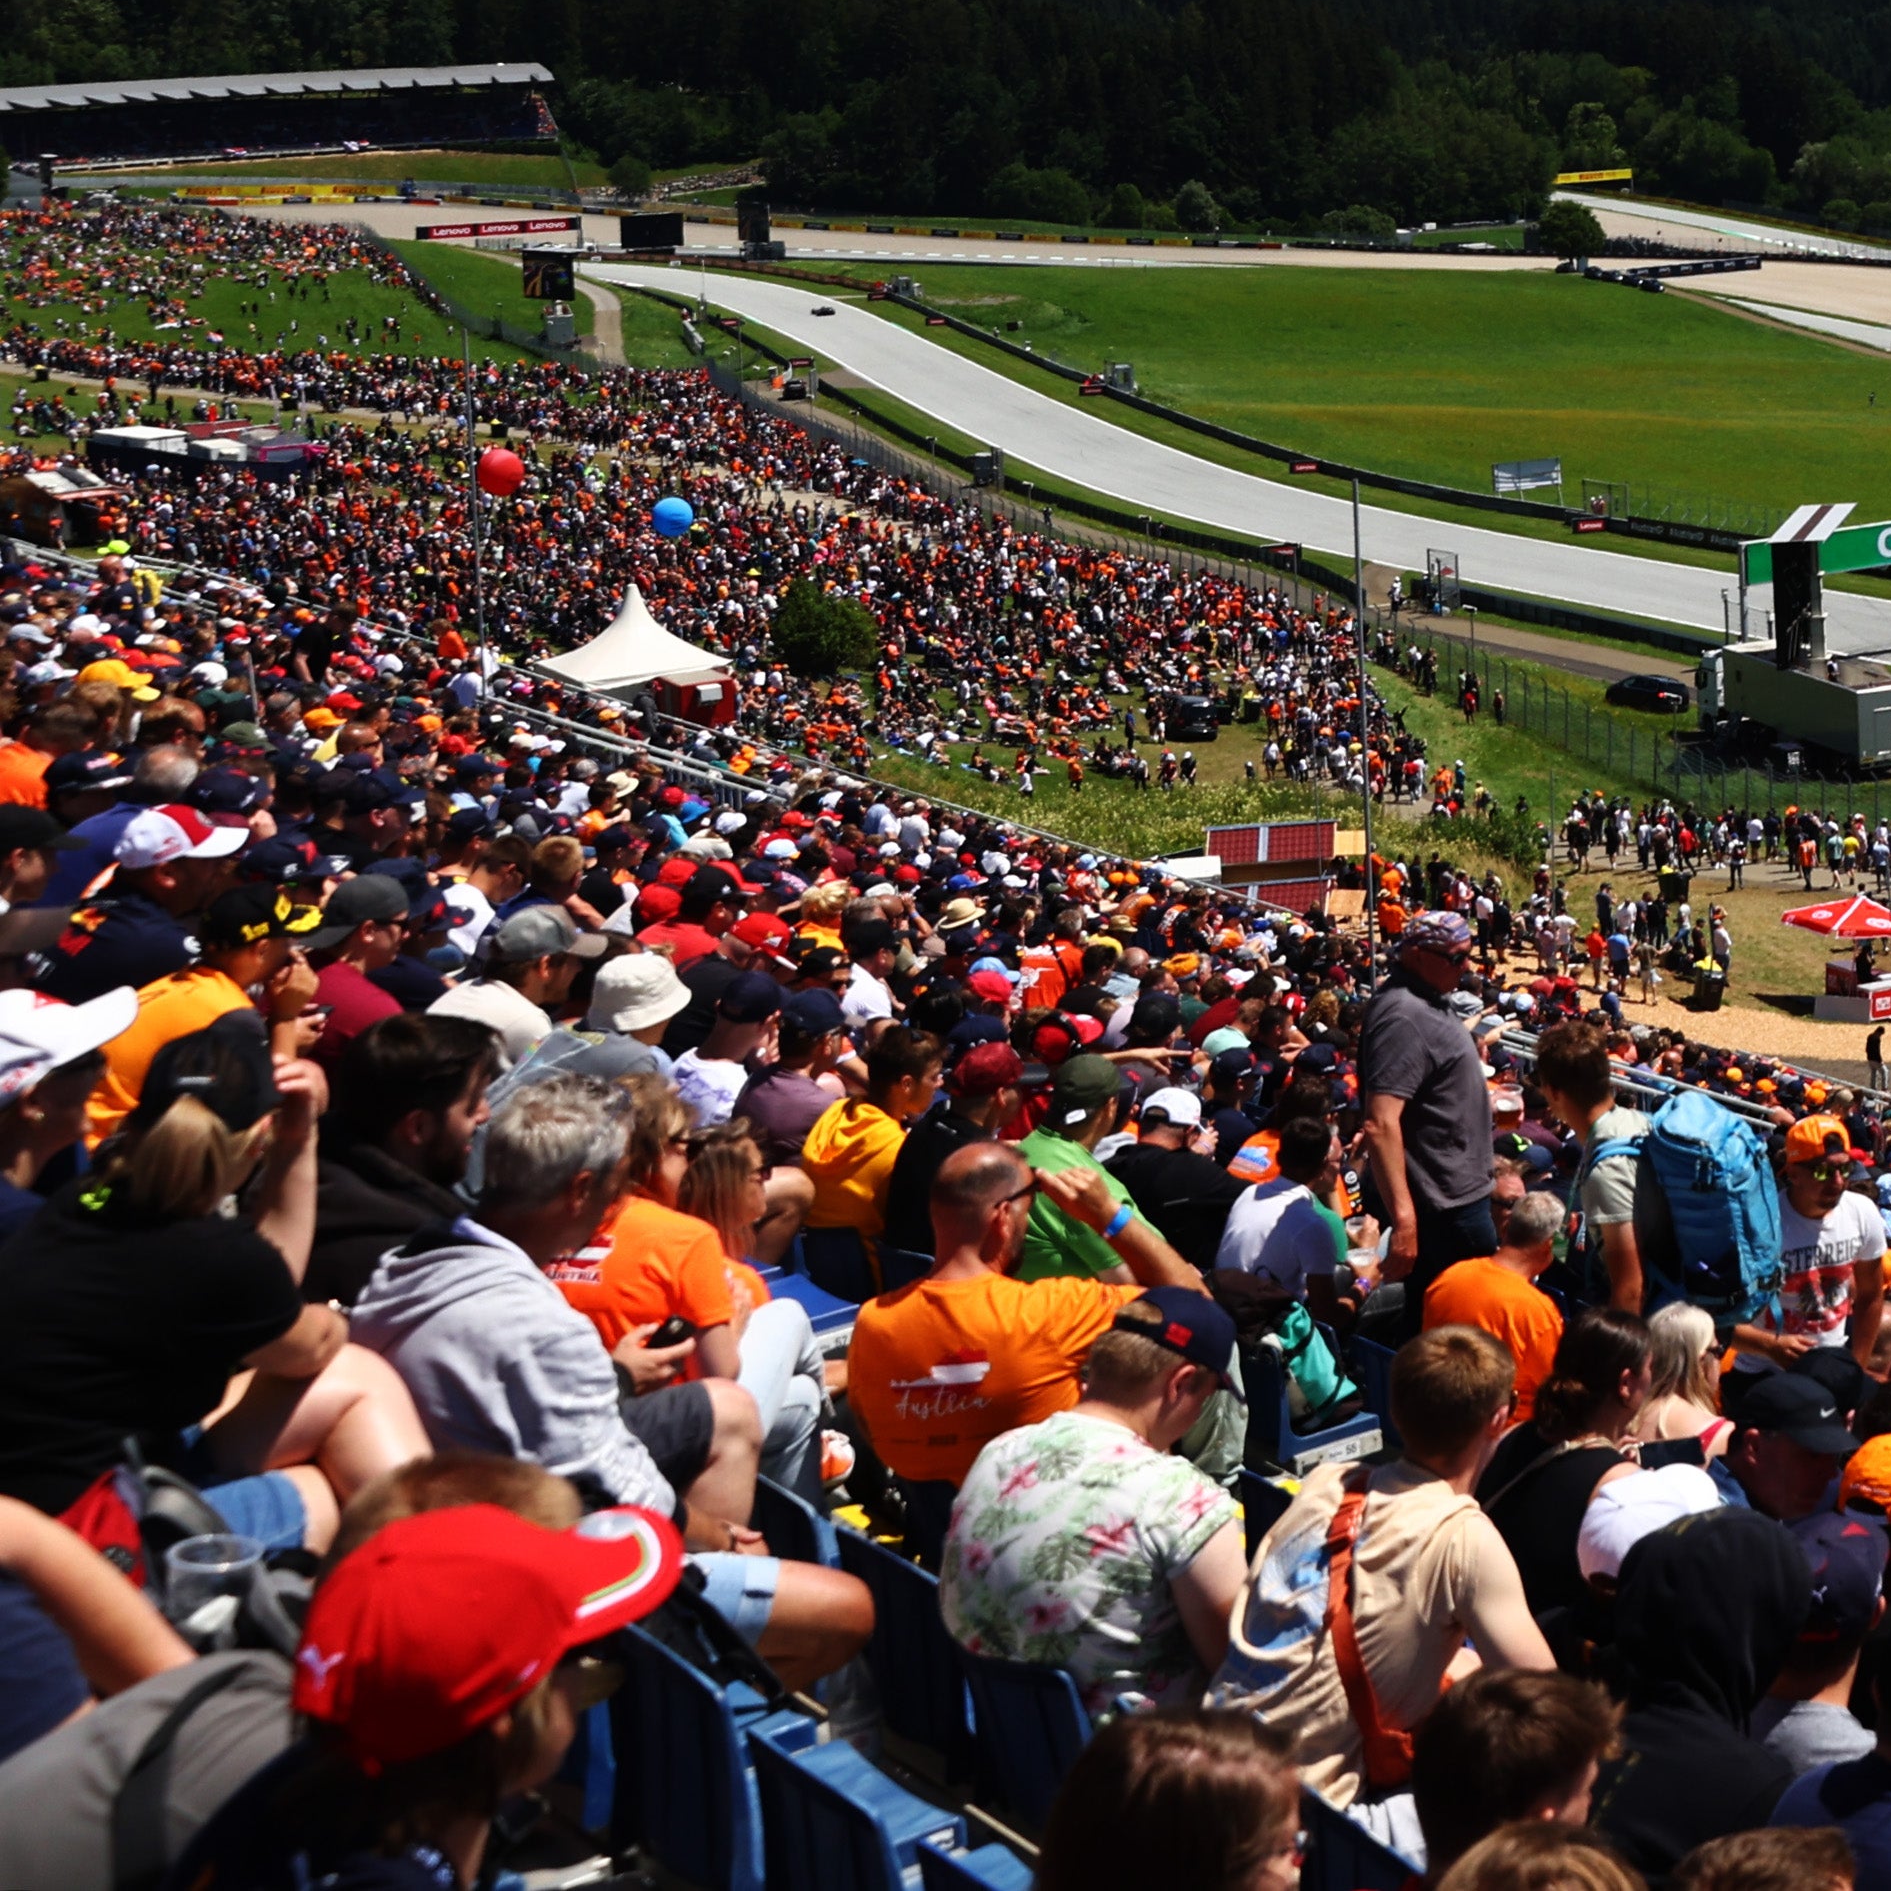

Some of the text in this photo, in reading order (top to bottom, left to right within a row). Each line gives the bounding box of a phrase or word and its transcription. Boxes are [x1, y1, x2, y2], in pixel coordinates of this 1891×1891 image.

[482, 224, 519, 233] Lenovo
[530, 221, 566, 231] Lenovo
[433, 227, 471, 236] Lenovo
[1579, 521, 1603, 530] Lenovo
